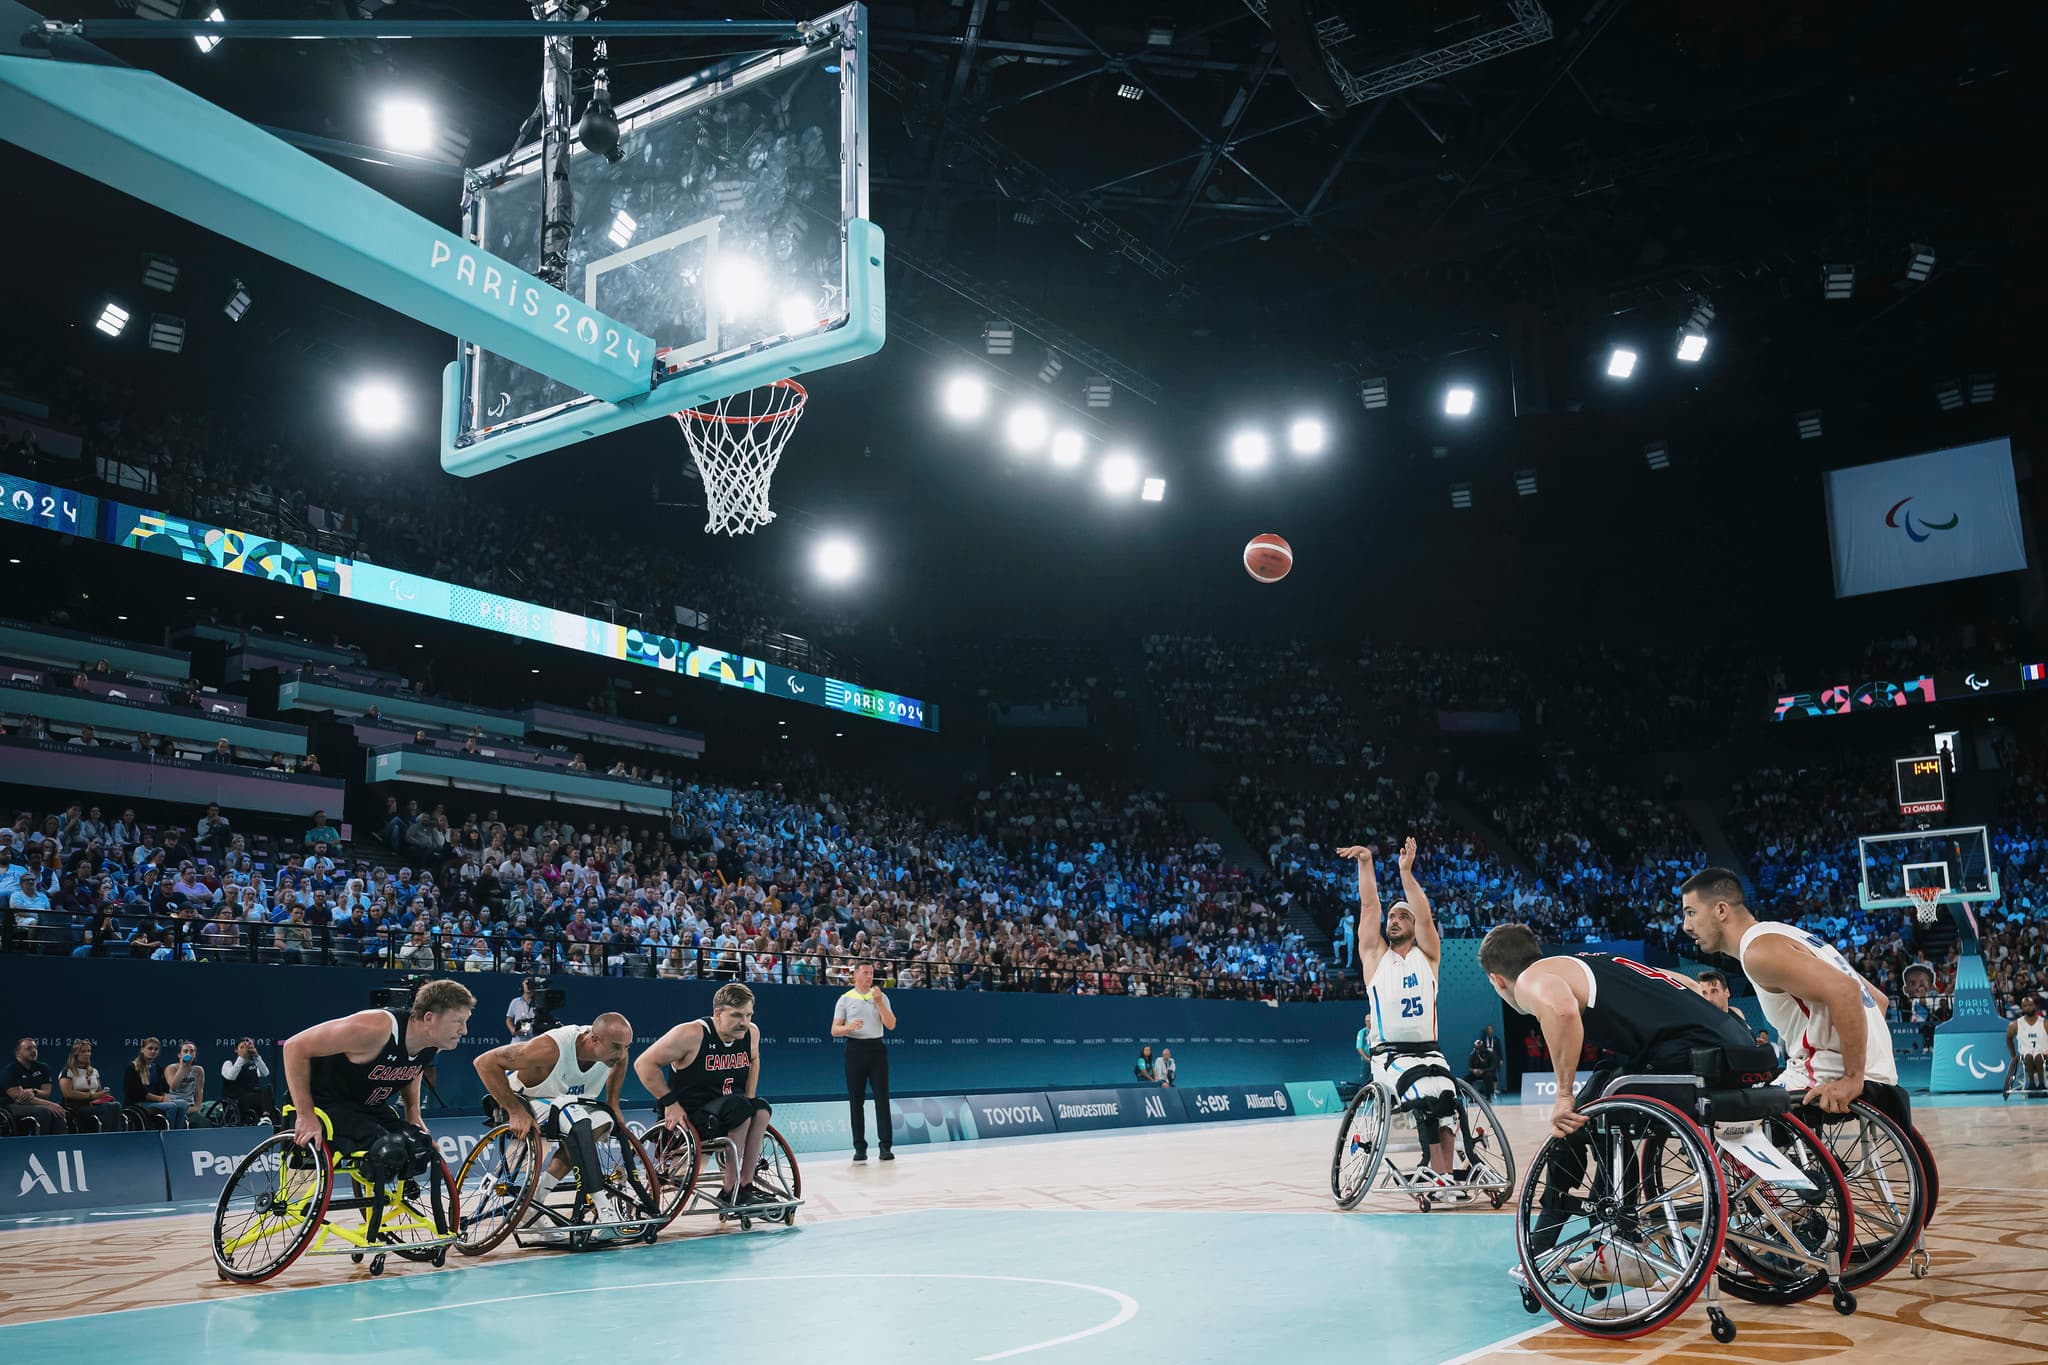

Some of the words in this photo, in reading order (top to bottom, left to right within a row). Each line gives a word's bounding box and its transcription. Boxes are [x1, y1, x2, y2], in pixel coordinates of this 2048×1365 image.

[554, 303, 641, 368] 2024
[889, 701, 923, 721] 2024
[1914, 761, 1938, 775] 1:44
[1912, 803, 1943, 813] OMEGA
[1401, 996, 1423, 1018] 25
[1960, 1008, 1990, 1016] 2024
[216, 1038, 236, 1046] PAR
[705, 1051, 750, 1071] CANADA
[1245, 1094, 1276, 1109] Allianz
[983, 1105, 1044, 1126] TOYOTA
[1058, 1103, 1119, 1119] BRIDGESTONE
